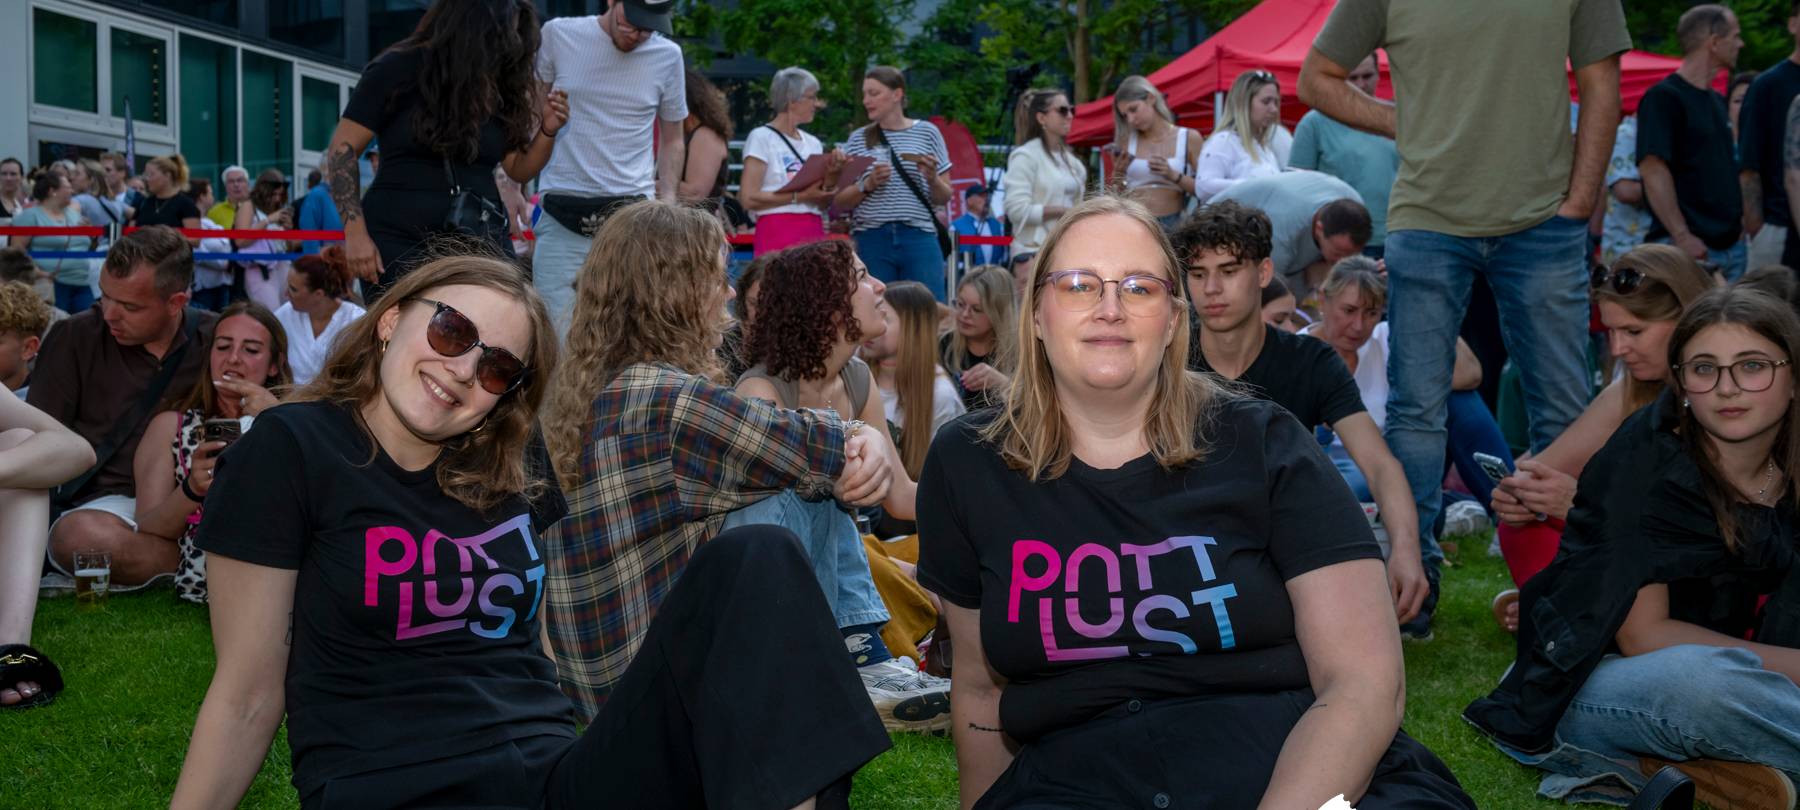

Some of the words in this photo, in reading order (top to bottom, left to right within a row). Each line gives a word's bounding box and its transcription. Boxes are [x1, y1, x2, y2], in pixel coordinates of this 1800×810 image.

[365, 514, 539, 606] POTT
[396, 563, 546, 640] LUST
[1008, 536, 1217, 623] POTT
[1039, 583, 1238, 662] LUST
